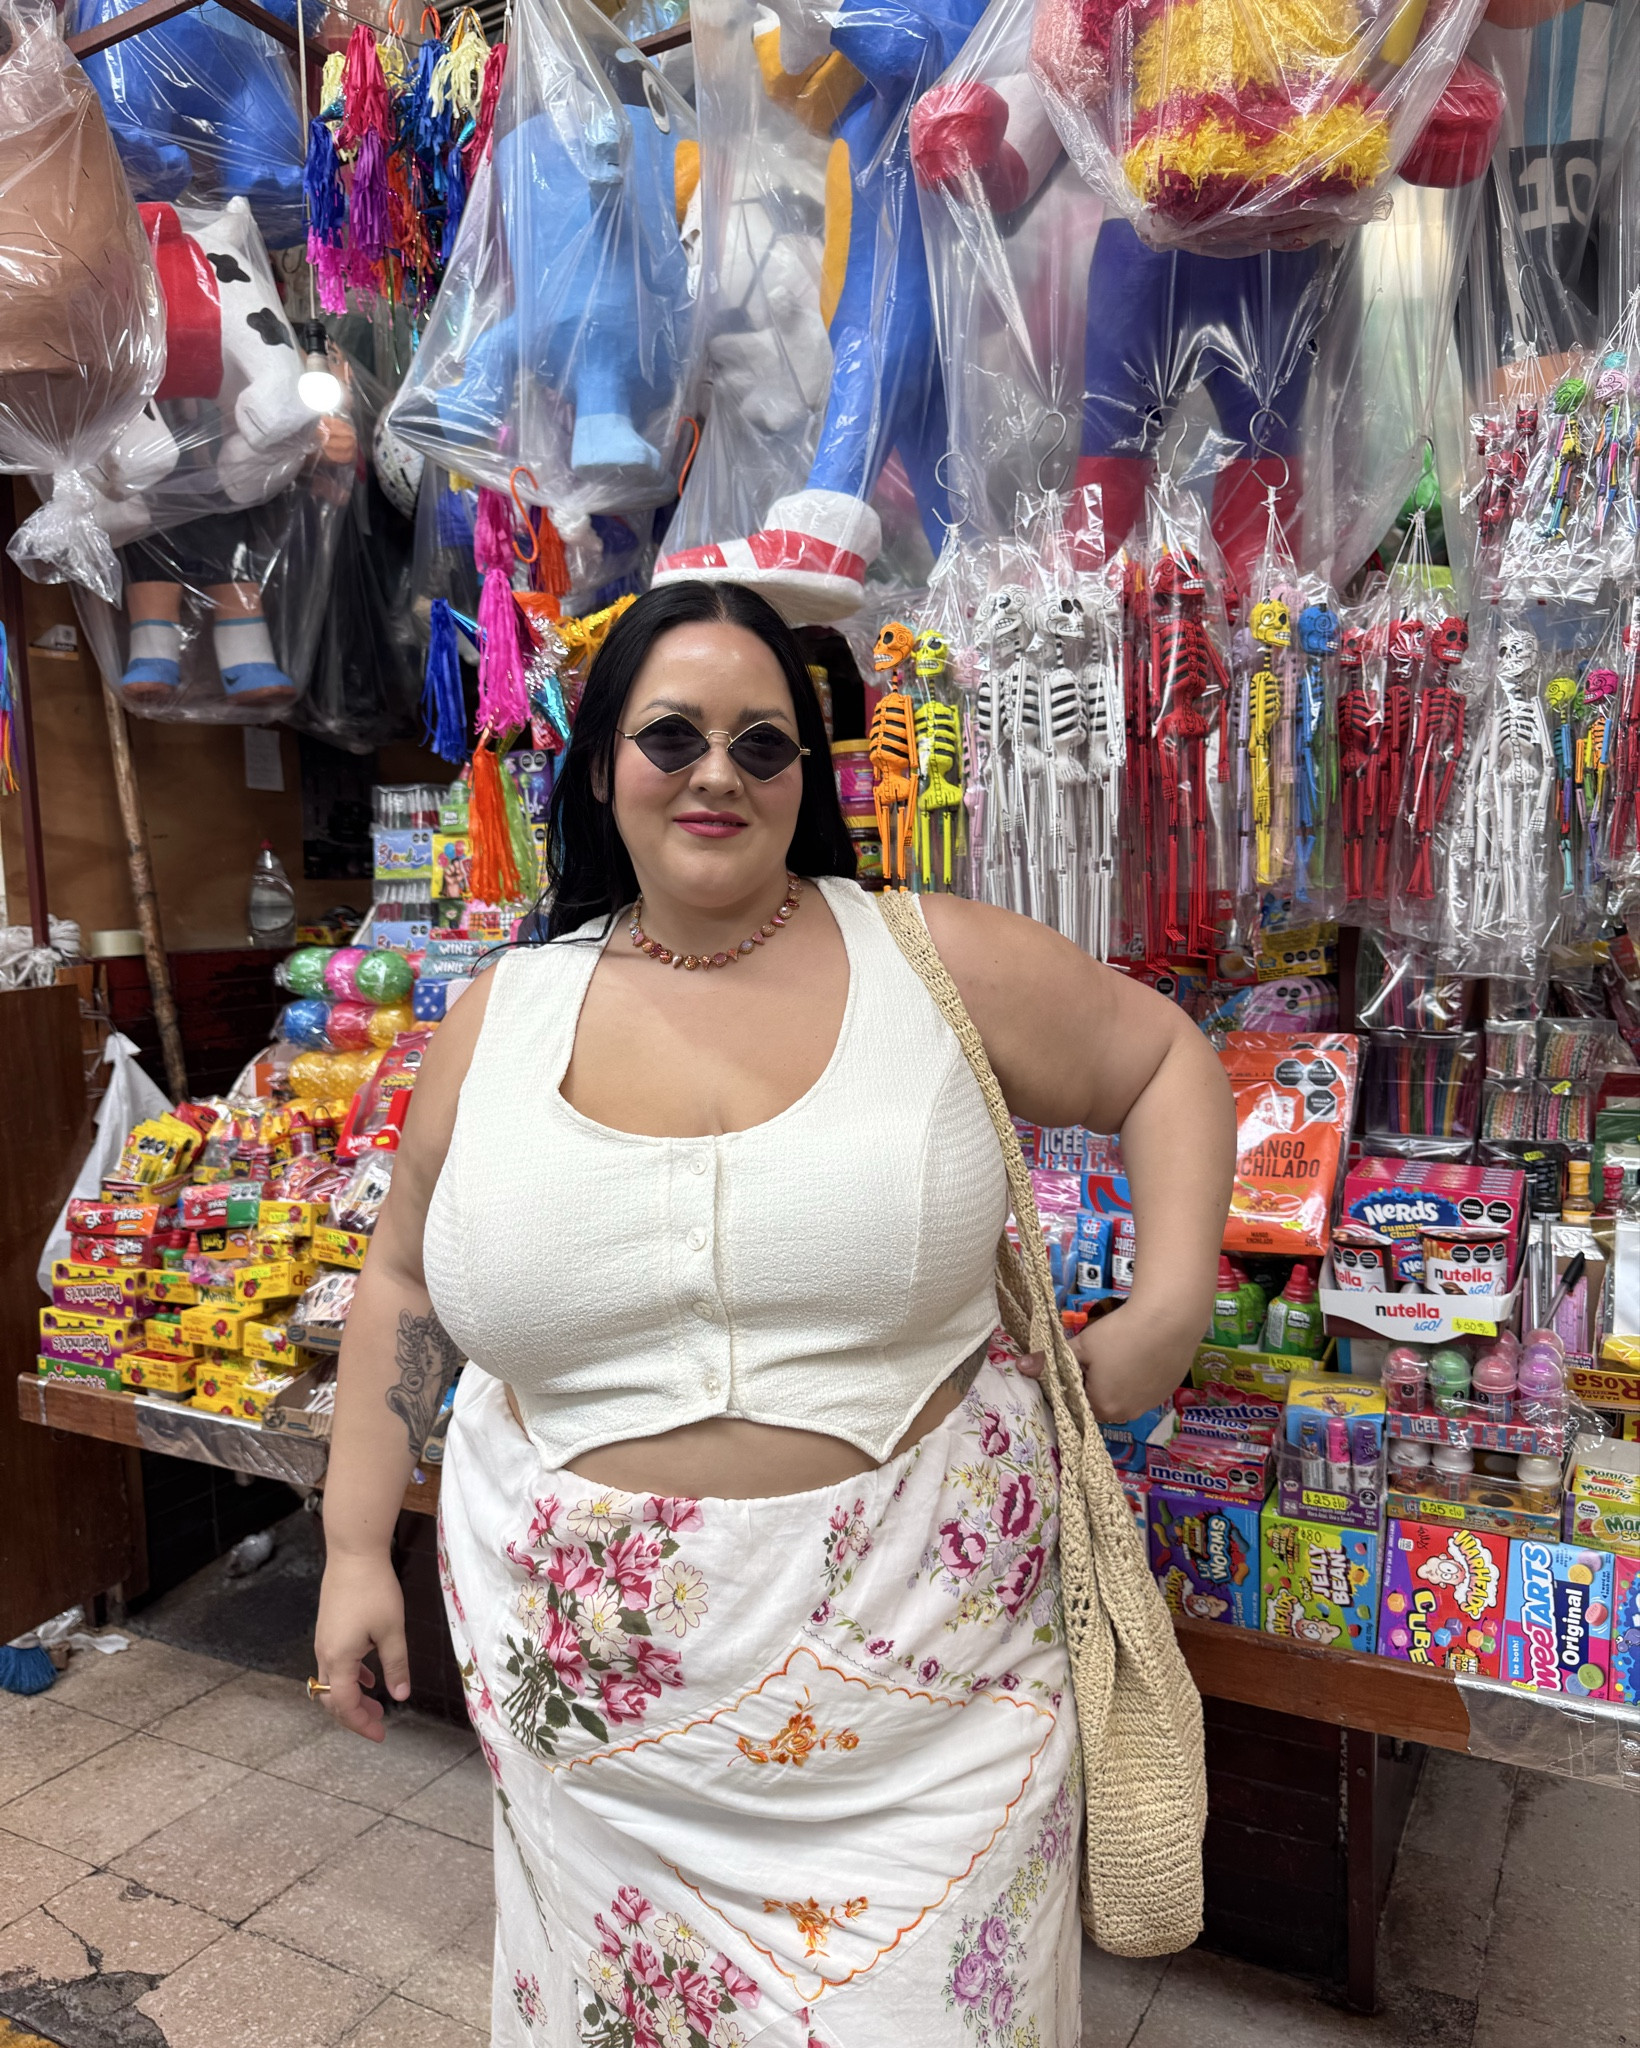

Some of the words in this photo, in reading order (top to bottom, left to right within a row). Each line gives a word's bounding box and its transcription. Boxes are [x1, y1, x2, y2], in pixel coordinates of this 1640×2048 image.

[1519, 157, 1597, 231] 10
[346, 1136, 373, 1148] AMOS
[1042, 1129, 1083, 1155] ICEE
[1434, 1267, 1492, 1282] nutella
[1469, 1281, 1494, 1295] &GO!
[1376, 1302, 1440, 1319] nutella
[1413, 1318, 1442, 1332] &GO!
[1572, 1372, 1640, 1400] Rosa
[1184, 1403, 1279, 1419] mentos
[1183, 1414, 1249, 1430] mentos
[1410, 1419, 1438, 1434] ICEE
[1183, 1425, 1238, 1441] mentos
[1150, 1465, 1228, 1490] mentos
[1583, 1469, 1635, 1485] Mamba
[1581, 1483, 1632, 1500] Mamba
[1210, 1518, 1228, 1580] WORMS
[1272, 1531, 1280, 1555] SOUR
[1309, 1544, 1330, 1598] JELLY
[1454, 1530, 1491, 1616] WARHEADS
[1561, 1588, 1584, 1666] Original
[1512, 1640, 1520, 1662] both!
[1513, 1663, 1520, 1675] be
